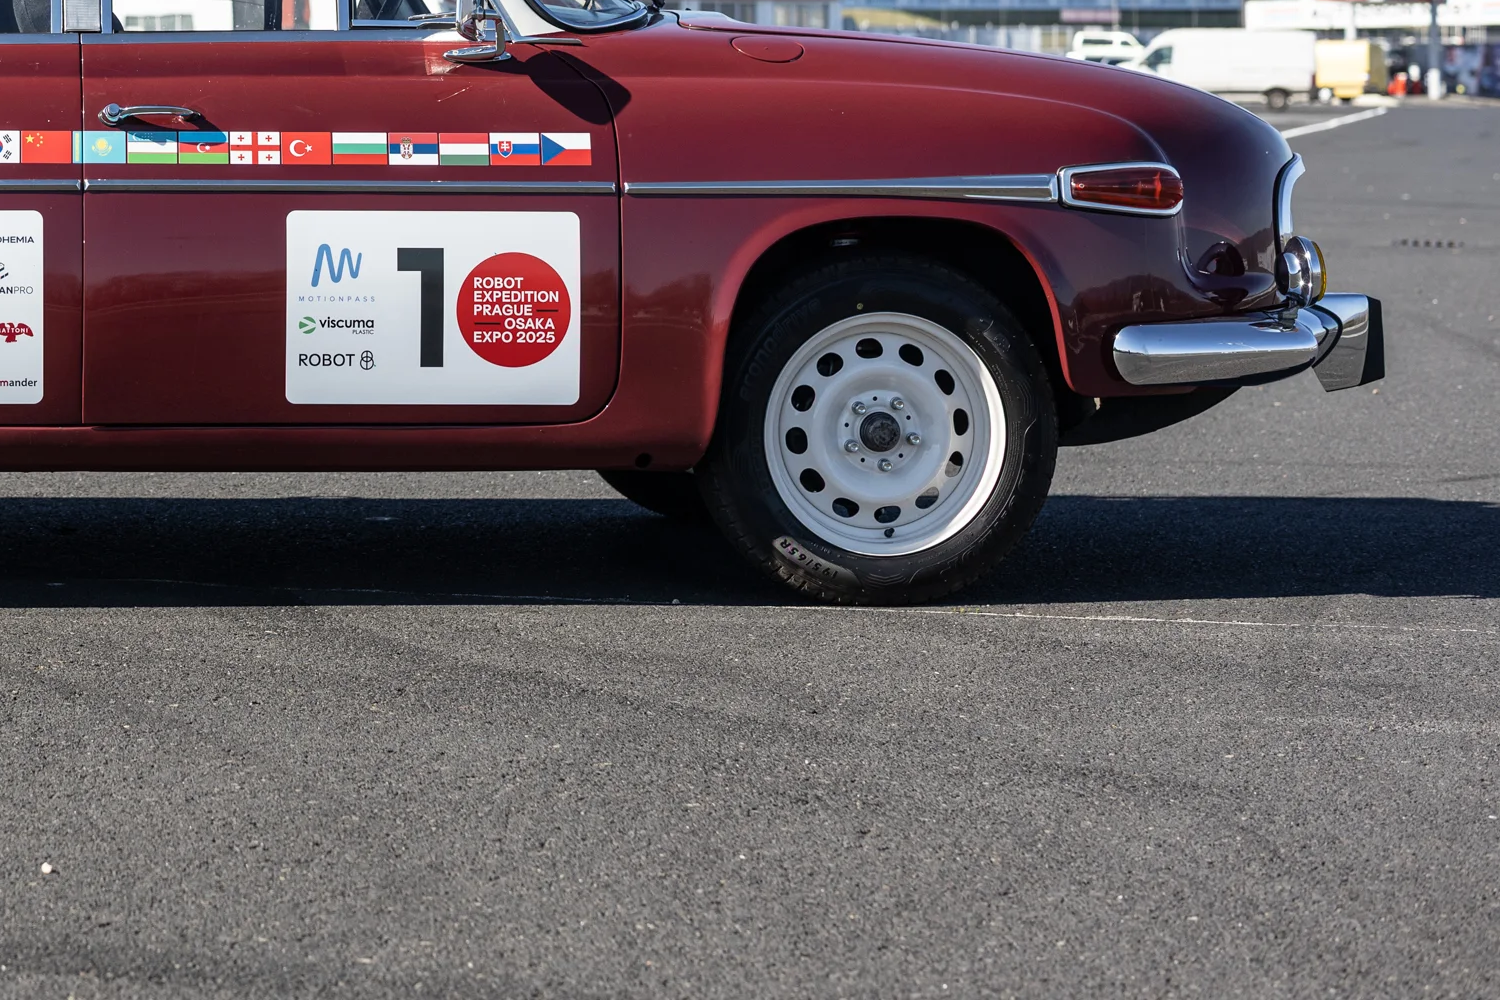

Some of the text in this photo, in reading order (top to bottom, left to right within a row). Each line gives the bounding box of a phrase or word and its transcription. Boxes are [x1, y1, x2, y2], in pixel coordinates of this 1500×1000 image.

[473, 277, 524, 289] ROBOT
[298, 295, 376, 303] MOTIONPASS
[473, 290, 559, 303] EXPEDITION
[397, 247, 444, 368] 1
[473, 304, 533, 316] PRAGUE
[319, 316, 375, 329] viscuma
[504, 317, 555, 330] OSAKA
[473, 331, 555, 343] EXPO 2025
[298, 353, 356, 367] ROBOT
